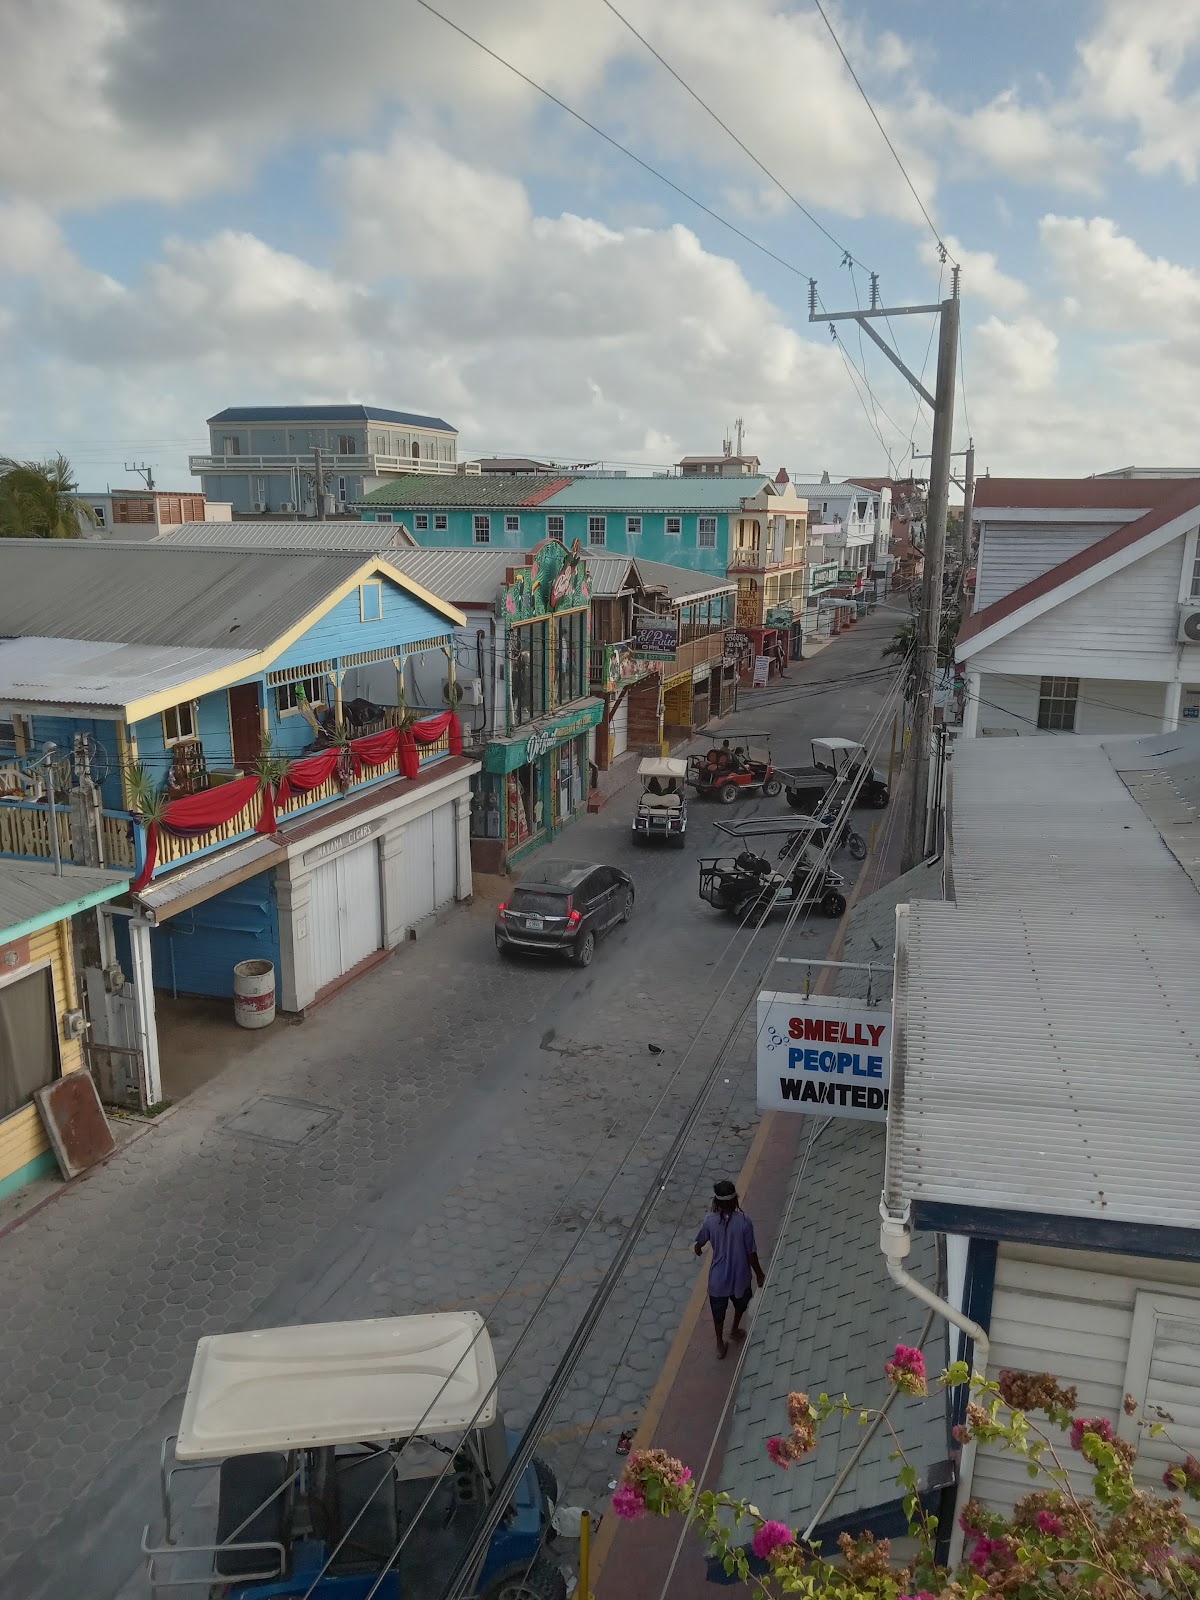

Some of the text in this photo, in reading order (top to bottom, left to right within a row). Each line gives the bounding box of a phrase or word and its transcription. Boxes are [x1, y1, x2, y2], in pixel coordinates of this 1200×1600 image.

[637, 629, 677, 647] El Patio
[318, 825, 372, 857] HAVANA CIGARS
[788, 1017, 886, 1047] SMELLY
[788, 1047, 883, 1078] PEOPLE
